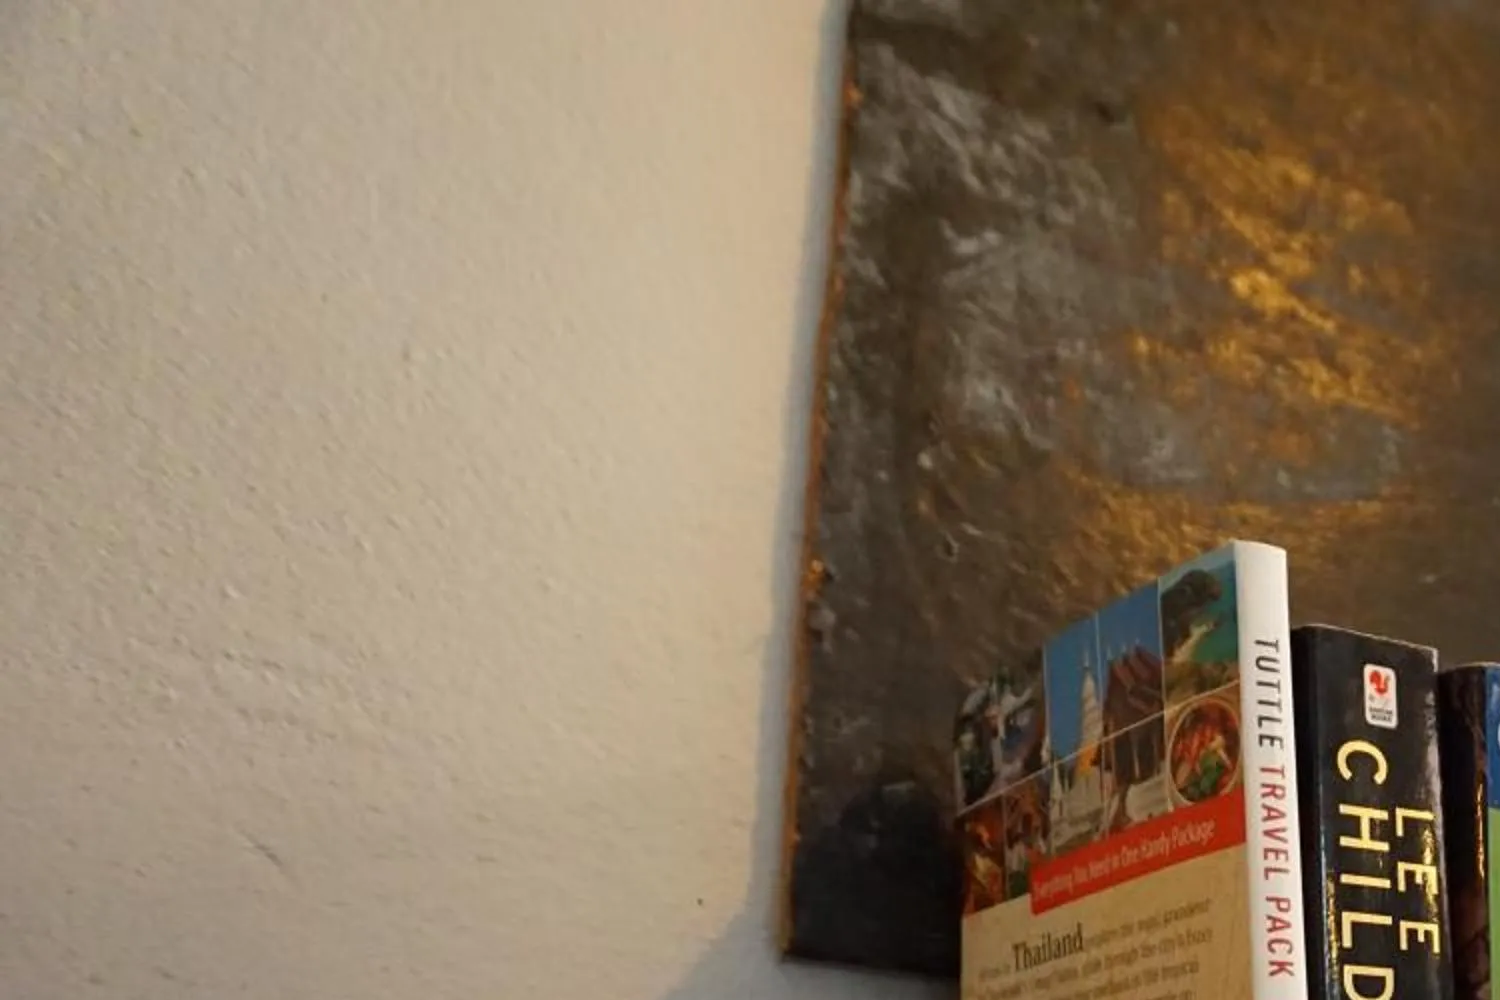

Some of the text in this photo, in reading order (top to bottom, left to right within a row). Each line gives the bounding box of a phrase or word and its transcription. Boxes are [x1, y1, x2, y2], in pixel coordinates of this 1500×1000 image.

[1254, 639, 1294, 978] TUTTLE TRAVEL PACK
[1395, 806, 1441, 954] LEE
[1012, 920, 1084, 972] Thailand
